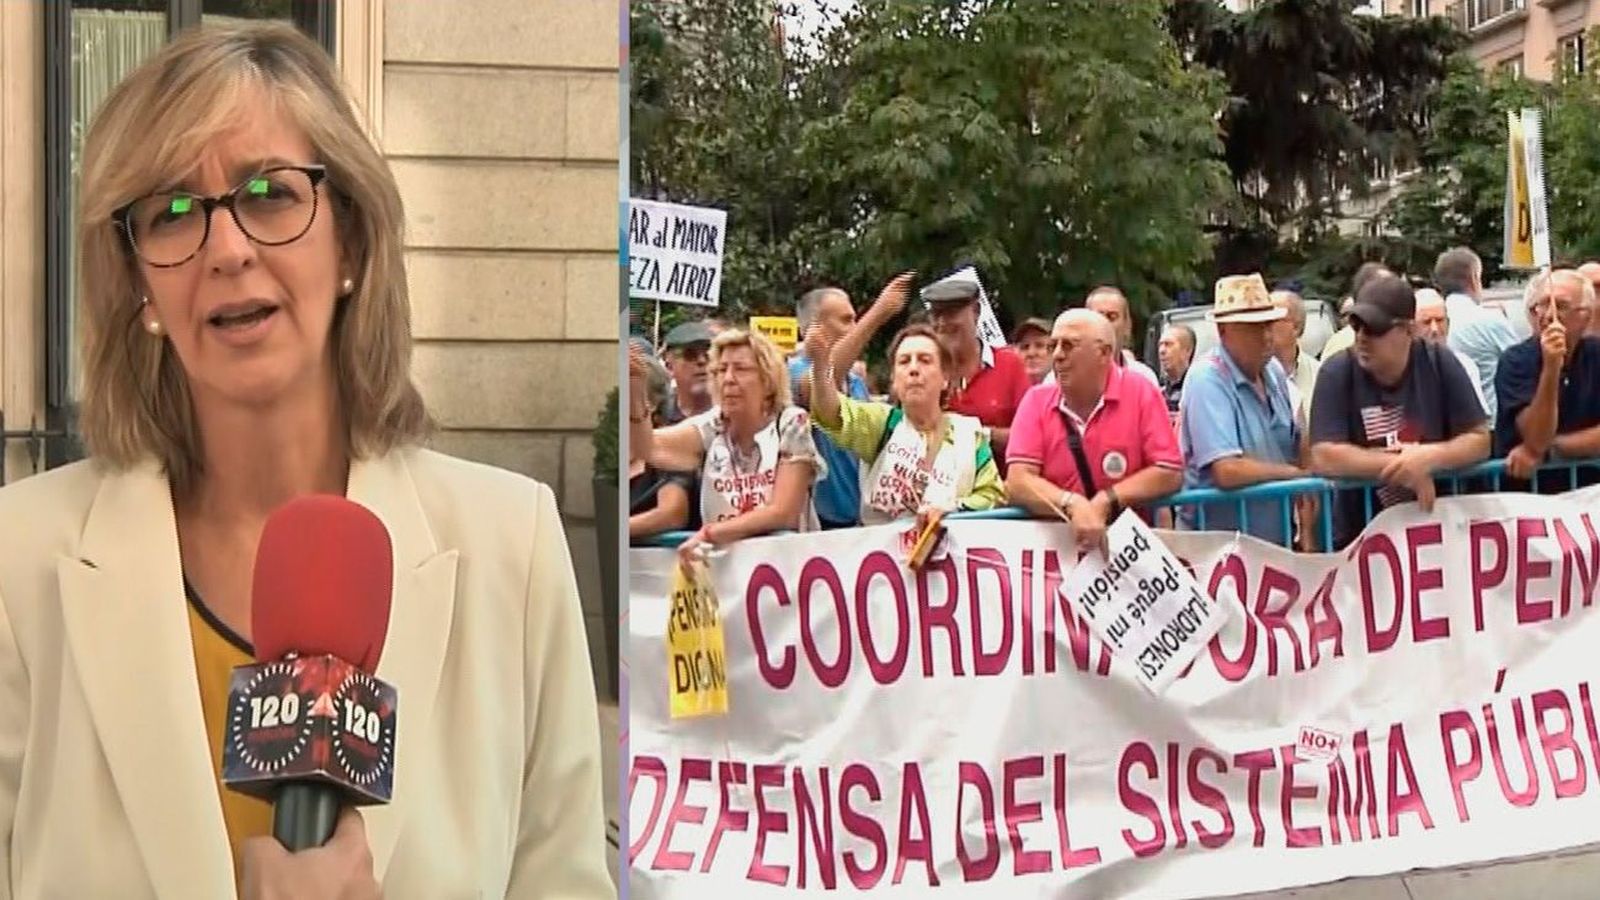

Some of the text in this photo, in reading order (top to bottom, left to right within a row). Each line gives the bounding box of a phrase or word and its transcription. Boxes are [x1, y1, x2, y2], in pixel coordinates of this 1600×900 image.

[653, 216, 668, 248] al
[672, 216, 719, 255] MAYOR
[1079, 526, 1151, 620] pensión!
[1106, 556, 1181, 649] ¡Pagué mi
[1358, 522, 1451, 654] DE
[1469, 512, 1600, 633] PEN
[251, 693, 300, 728] 120
[344, 698, 380, 743] 120
[629, 755, 941, 890] DEFENSA
[955, 752, 1103, 882] DEL
[1117, 721, 1436, 859] SISTEMA
